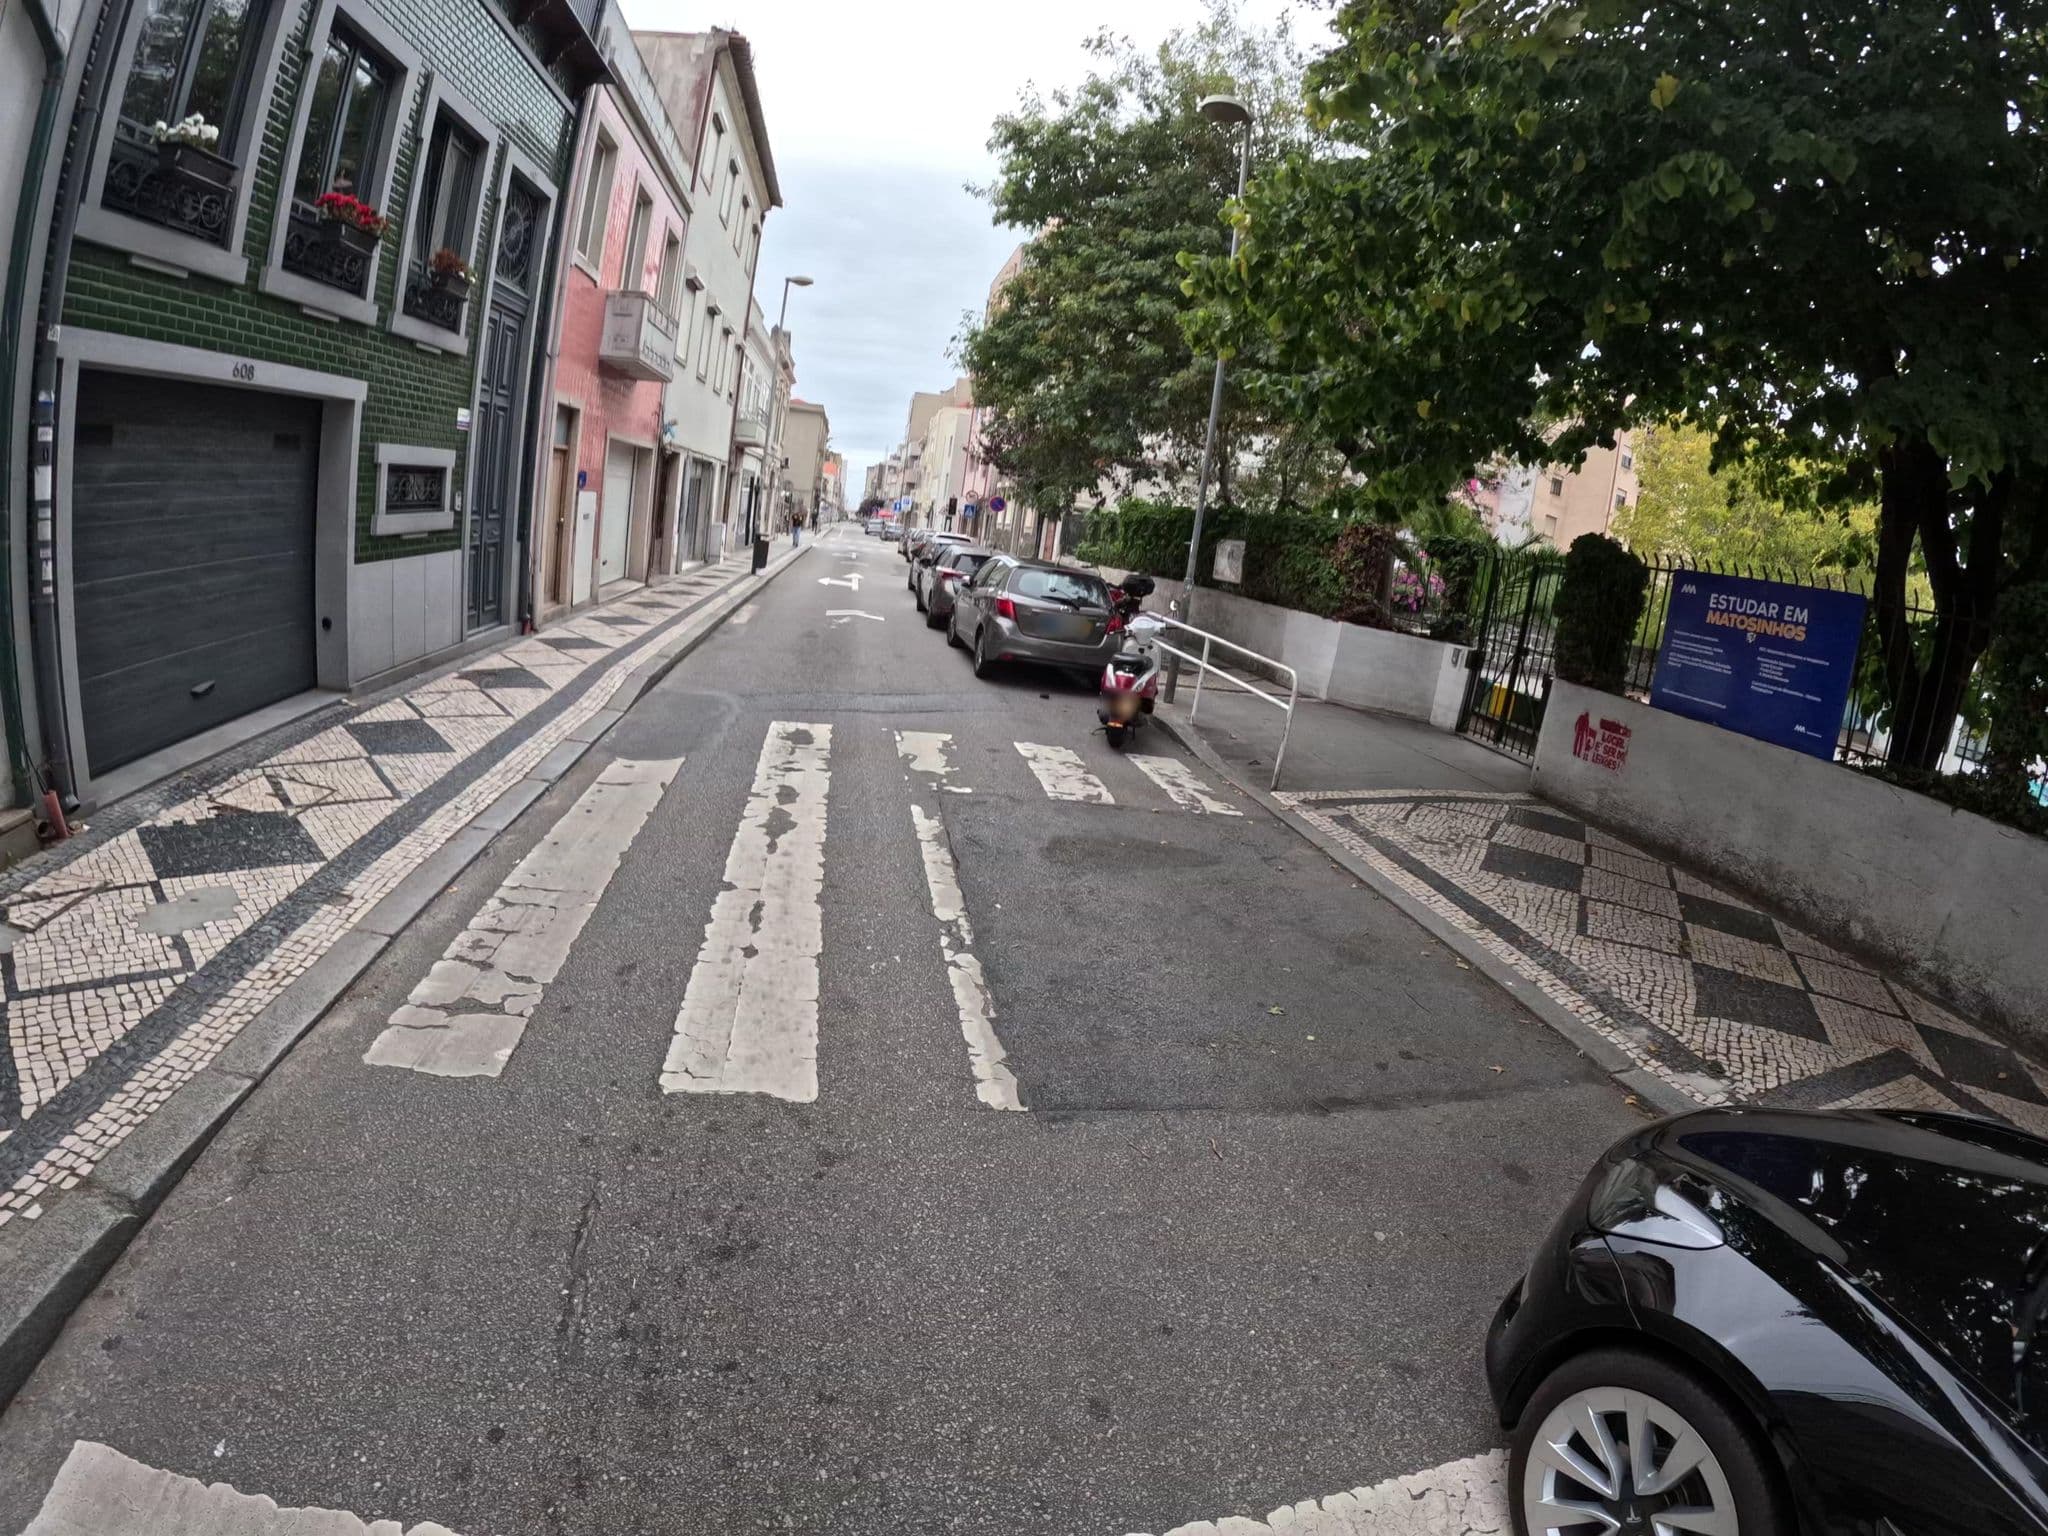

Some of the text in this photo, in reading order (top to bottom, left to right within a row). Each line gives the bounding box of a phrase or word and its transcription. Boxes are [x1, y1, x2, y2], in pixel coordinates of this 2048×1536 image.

[232, 361, 255, 381] 608
[1709, 593, 1809, 625] ESTUDAR EM
[1706, 610, 1807, 642] MATOSINHOS
